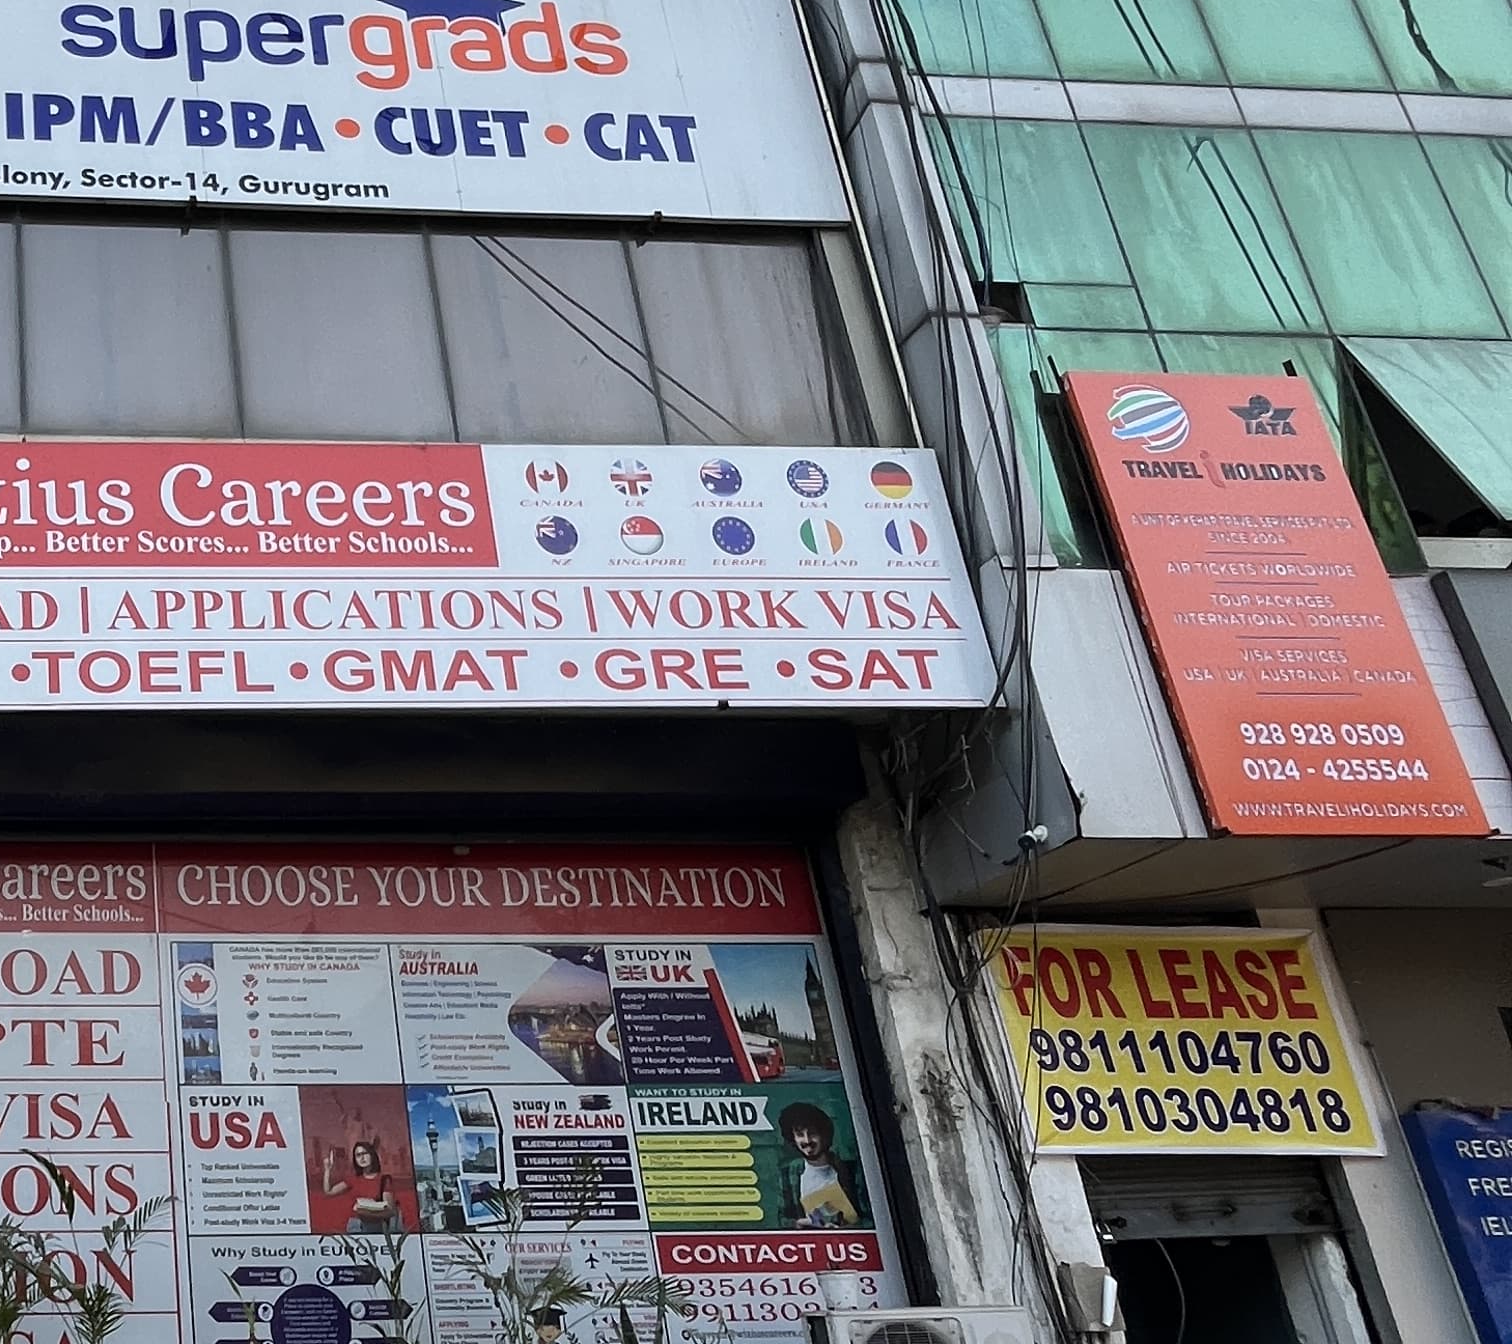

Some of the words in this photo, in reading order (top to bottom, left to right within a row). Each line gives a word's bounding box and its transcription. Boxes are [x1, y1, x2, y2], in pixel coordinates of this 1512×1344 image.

[59, 0, 630, 90] supergrads
[3, 90, 325, 154] IPM/BBA
[373, 106, 531, 158] CUET
[582, 112, 698, 165] CAT
[80, 167, 229, 197] Sector-14,
[238, 173, 391, 202] Gurugram
[1245, 420, 1297, 436] IATA
[1122, 460, 1204, 479] TRAVEL
[1220, 462, 1327, 482] HOLIDAYS
[158, 461, 477, 529] Careers
[519, 499, 584, 508] CANADA
[690, 499, 764, 509] AUSTRALIA
[45, 531, 133, 555] Better
[136, 531, 250, 555] Scores...
[256, 531, 344, 555] Better
[348, 531, 474, 556] Schools...
[107, 588, 564, 631] APPLICATIONS
[607, 588, 807, 631] WORK
[816, 588, 961, 630] VISA
[31, 650, 276, 694] TOEFL
[323, 648, 529, 692] GMAT
[593, 648, 751, 691] GRE
[809, 648, 939, 690] SAT
[1240, 722, 1287, 745] 928
[1290, 723, 1337, 745] 928
[1340, 723, 1405, 747] 0509
[1242, 758, 1301, 781] 0124
[1322, 759, 1430, 782] 4255544
[175, 863, 360, 908] CHOOSE
[367, 865, 493, 909] YOUR
[500, 865, 788, 910] DESTINATION
[399, 961, 479, 976] AUSTRALIA
[650, 965, 696, 983] UK
[1001, 946, 1128, 1019] FOR
[1125, 947, 1319, 1021] LEASE
[1029, 1027, 1332, 1077] 9811104760
[514, 1115, 550, 1130] NEW
[553, 1113, 626, 1129] ZEALAND
[638, 1100, 759, 1127] IRELAND
[1045, 1084, 1353, 1134] 9810304818
[189, 1111, 287, 1150] USA
[671, 1243, 817, 1265] CONTACT
[826, 1242, 868, 1263] US
